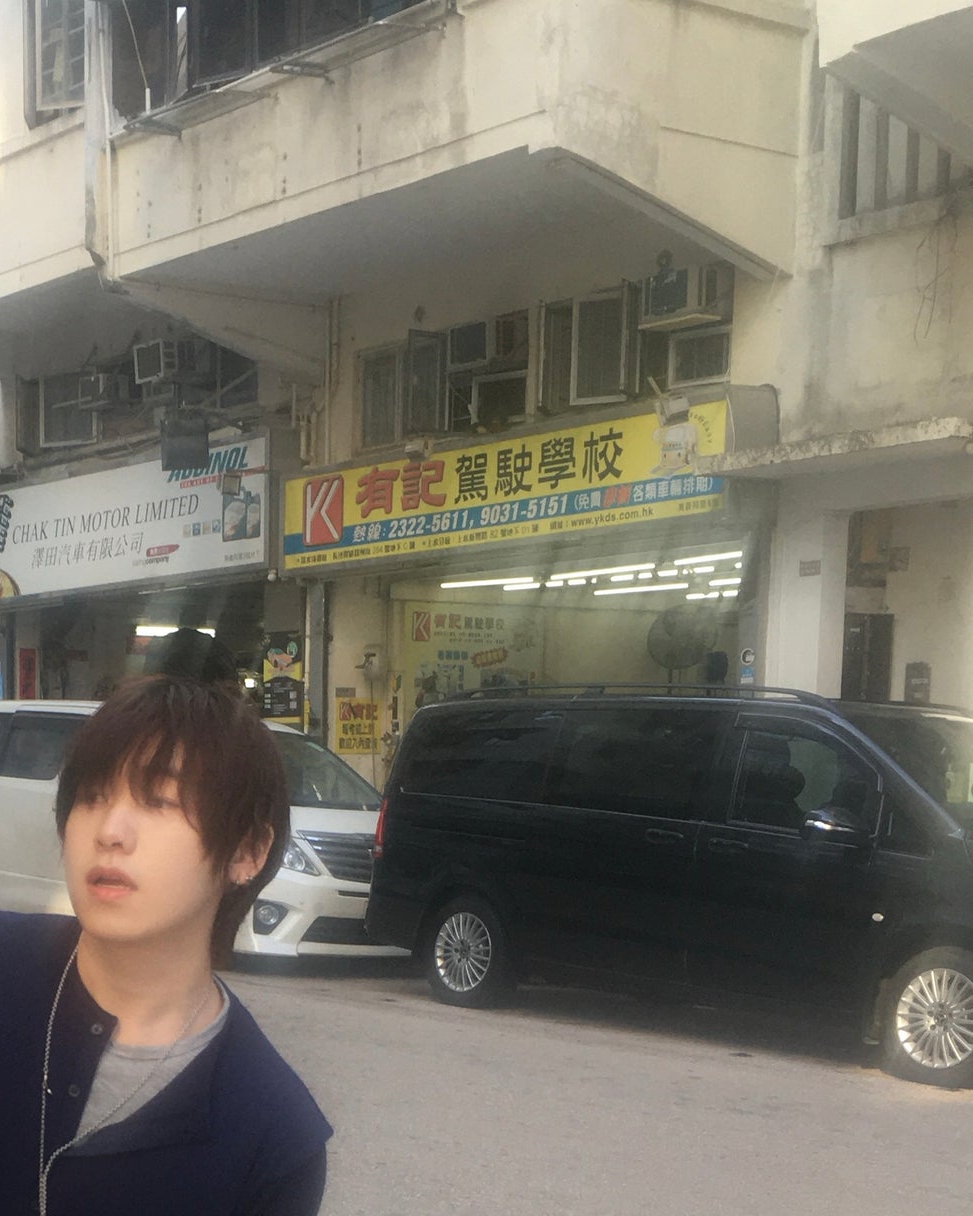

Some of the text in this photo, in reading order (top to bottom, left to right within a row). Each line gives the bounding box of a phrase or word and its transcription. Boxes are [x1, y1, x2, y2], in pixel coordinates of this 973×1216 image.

[12, 521, 48, 545] CHAK
[54, 516, 76, 539] TIN
[80, 506, 130, 534] MOTOR
[135, 493, 199, 524] LIMITED
[480, 495, 568, 526] 9031-5151
